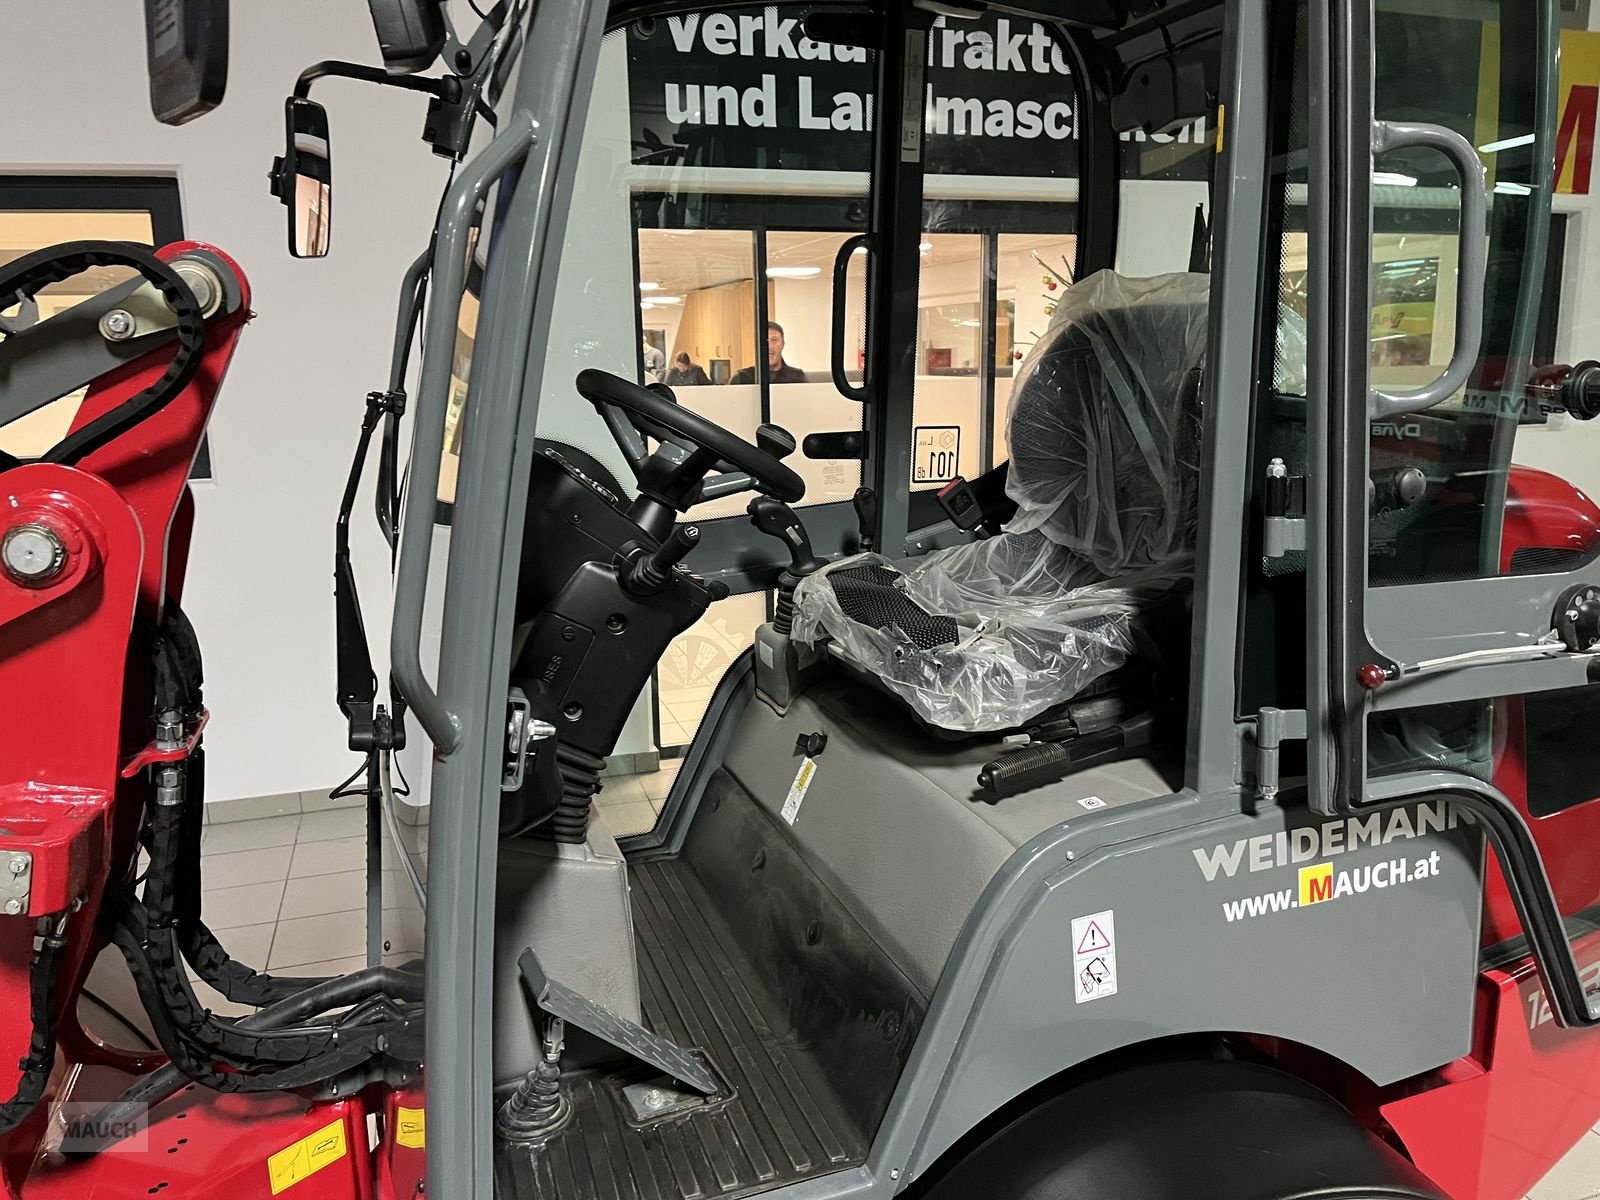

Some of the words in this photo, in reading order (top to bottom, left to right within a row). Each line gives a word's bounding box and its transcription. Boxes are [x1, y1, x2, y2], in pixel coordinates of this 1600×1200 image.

[667, 6, 875, 63] verka
[665, 74, 777, 128] und
[1223, 851, 1440, 922] www.MAUCH.at
